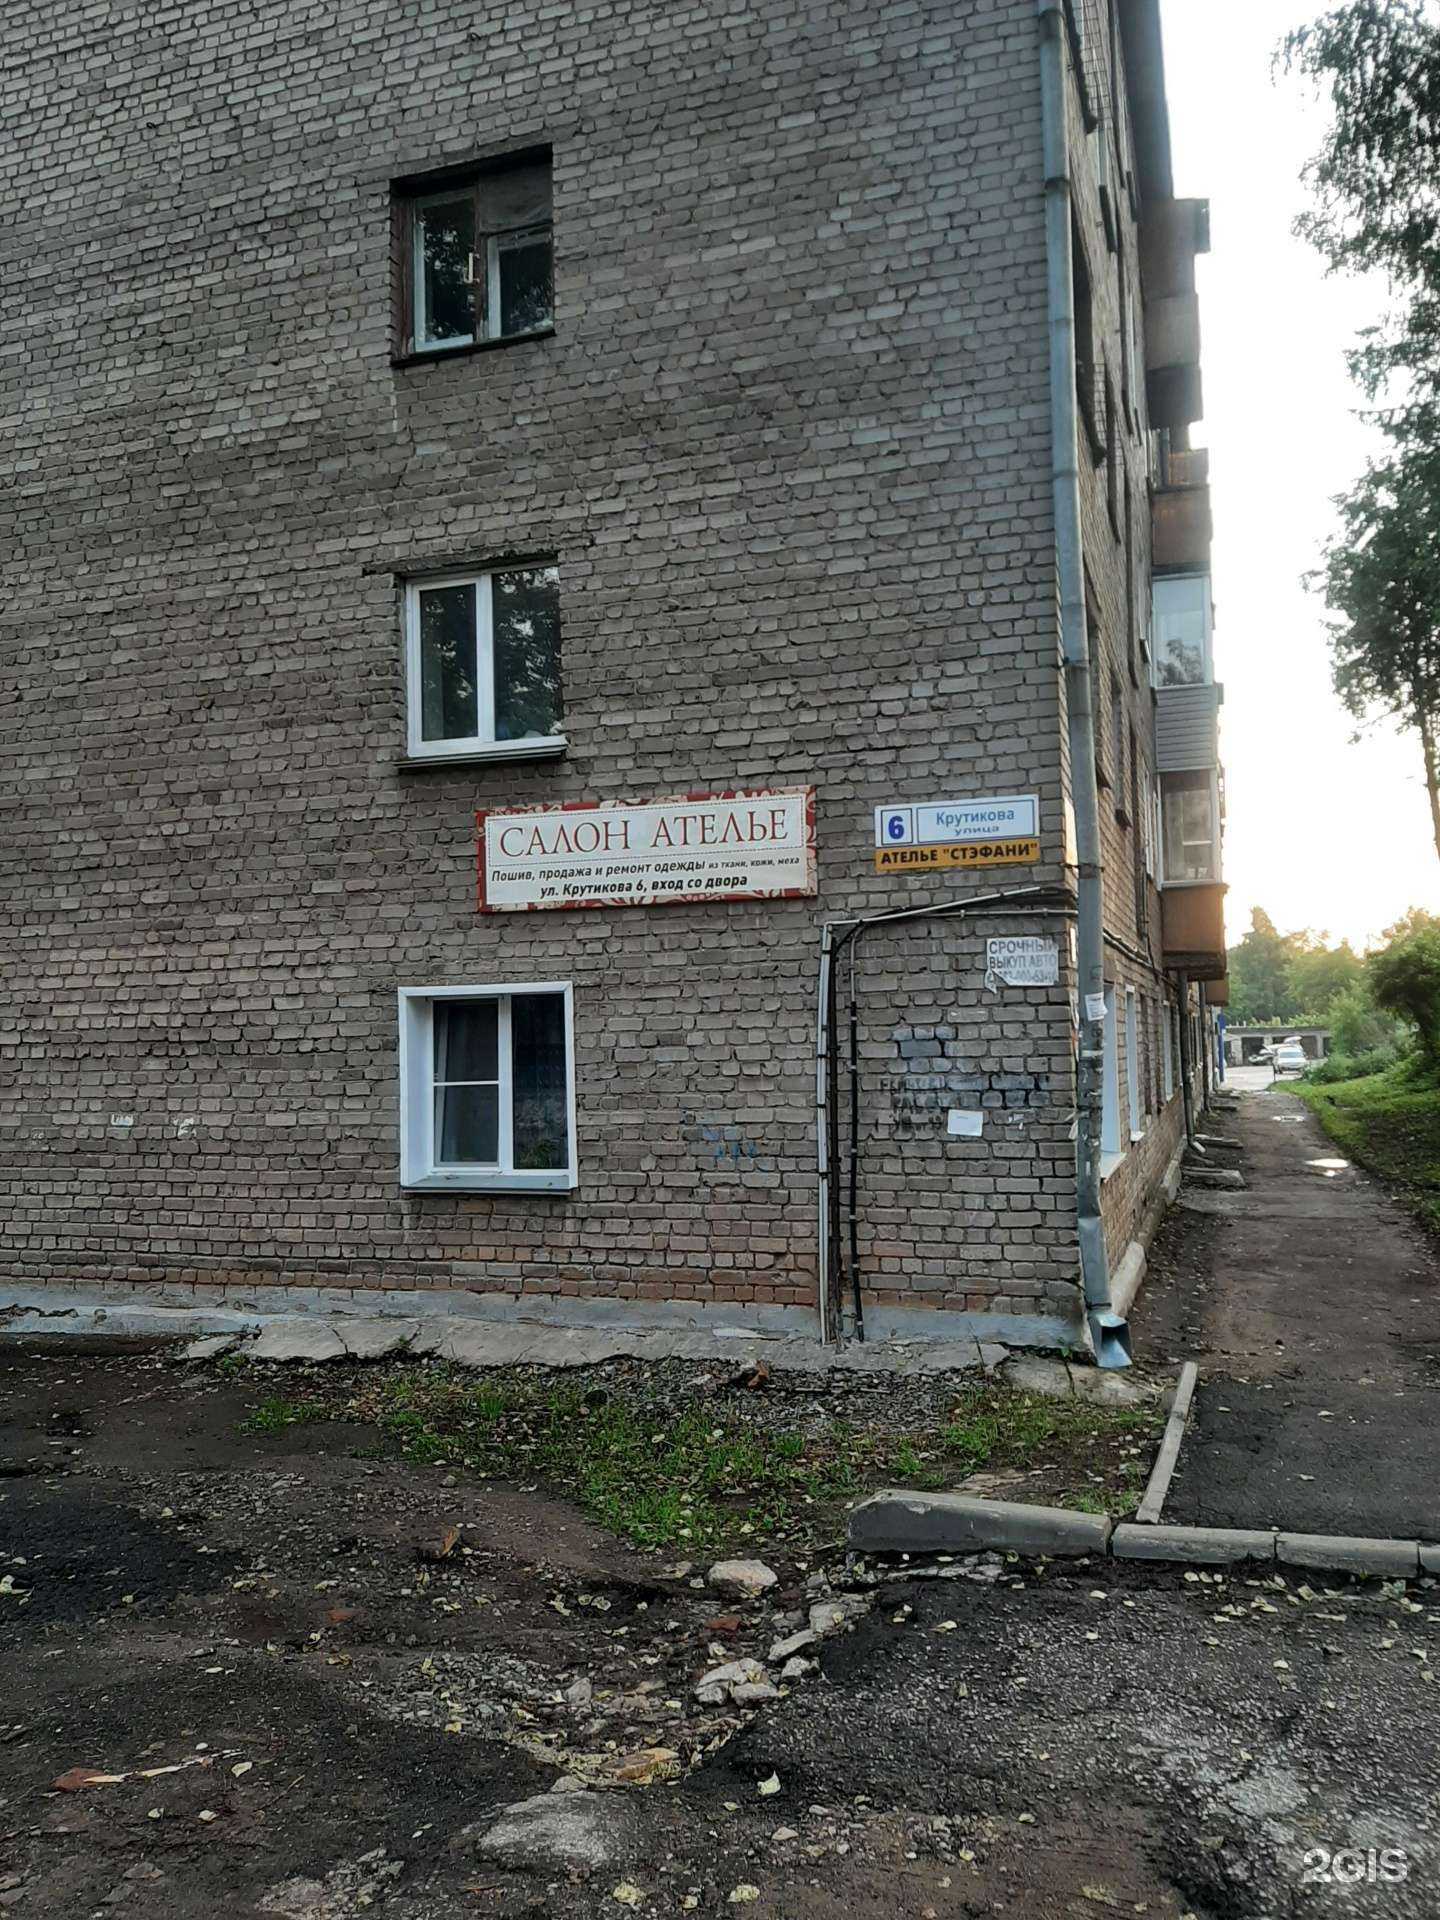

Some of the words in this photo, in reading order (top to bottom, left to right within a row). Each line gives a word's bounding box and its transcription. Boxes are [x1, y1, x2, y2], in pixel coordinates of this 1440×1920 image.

[888, 815, 905, 839] 6
[936, 808, 1014, 826] Крутикова
[500, 819, 630, 858] САЛОН
[651, 808, 789, 849] АТЕЛЬЕ
[954, 825, 1000, 836] улица
[881, 849, 938, 865] АТЕЛЬЕ
[943, 842, 1038, 861] "СТЭФАНИ"
[492, 870, 535, 882] Пошив,
[539, 867, 592, 881] продажа
[595, 866, 602, 876] и
[605, 864, 651, 877] ремонт
[654, 860, 706, 874] одежды
[721, 860, 748, 868] ткани,
[750, 858, 775, 867] кожи,
[777, 856, 800, 865] меха
[540, 885, 558, 898] ул.
[562, 881, 632, 898] Крутикова
[636, 879, 647, 893] 6,
[651, 878, 683, 891] вход
[687, 878, 702, 889] со
[705, 875, 747, 890] двора
